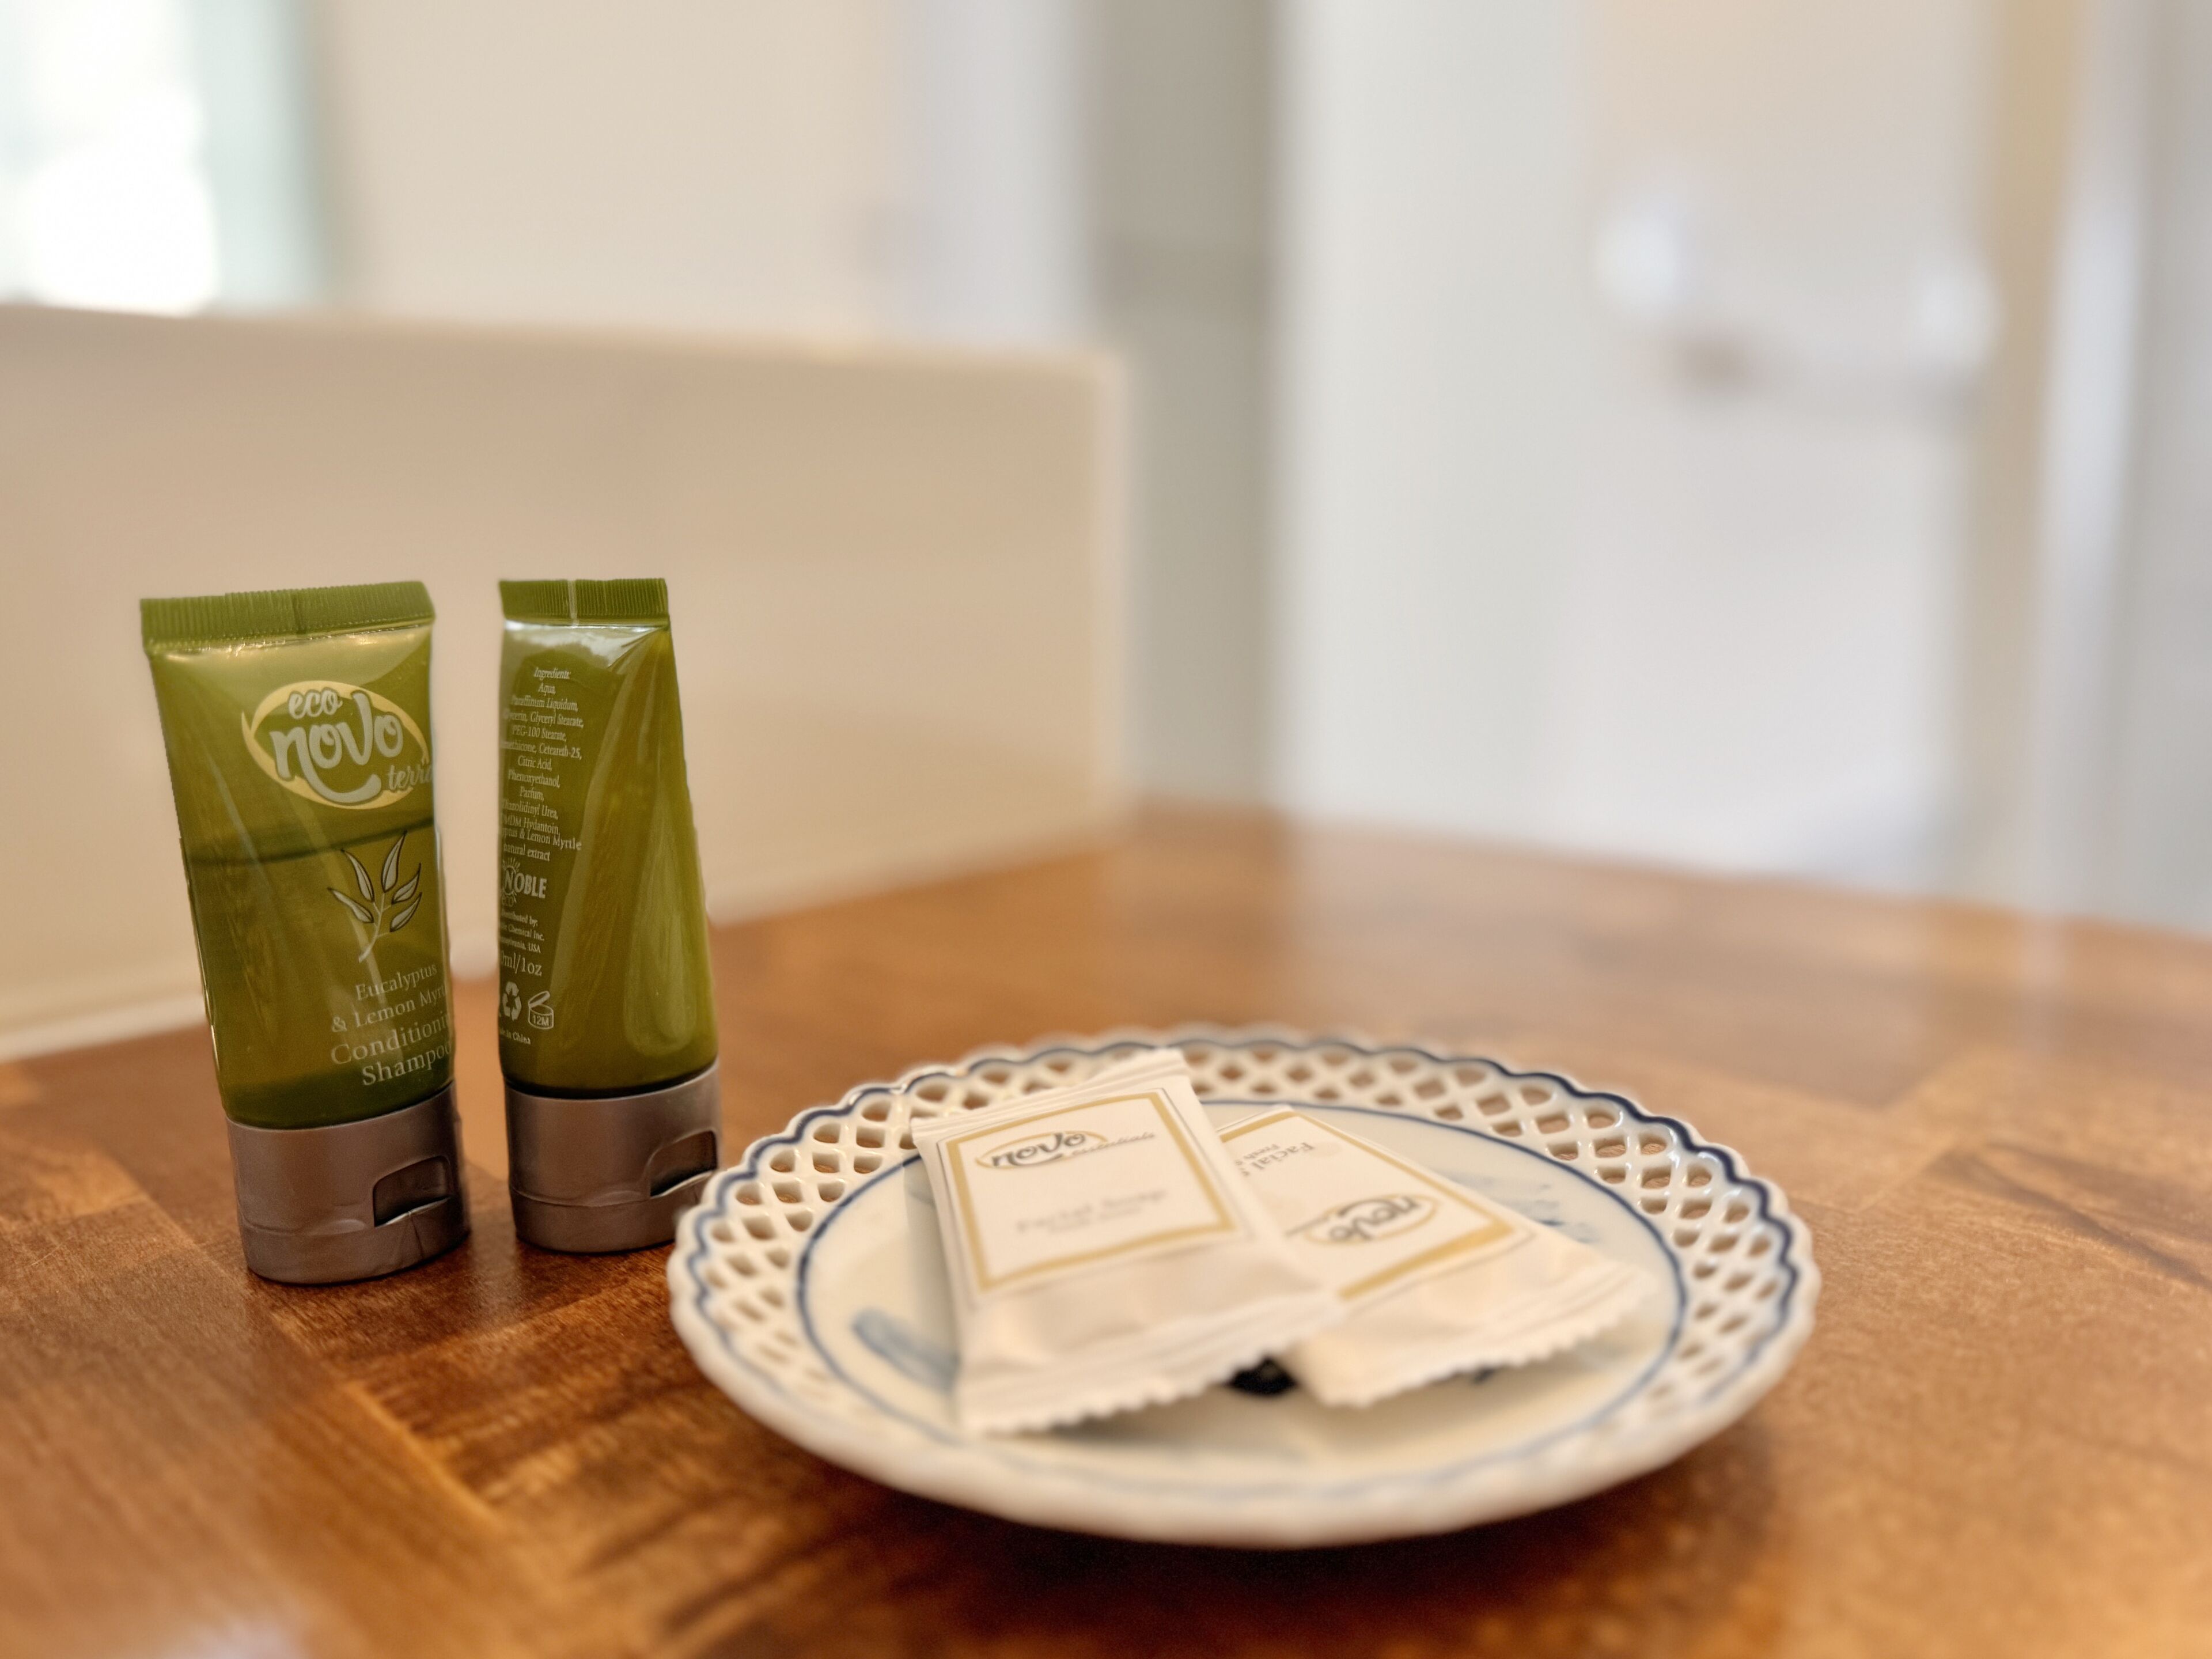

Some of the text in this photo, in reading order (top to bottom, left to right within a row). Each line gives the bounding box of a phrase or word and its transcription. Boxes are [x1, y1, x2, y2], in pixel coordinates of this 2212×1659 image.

[289, 690, 343, 719] eco
[518, 756, 536, 768] Citric
[527, 828, 550, 844] Lemon
[553, 835, 582, 850] Myrtle
[527, 848, 550, 862] extract
[505, 869, 547, 899] NOBLE
[528, 942, 541, 954] USA
[355, 964, 437, 1001] Eucalyptus
[331, 1016, 347, 1033] &
[354, 999, 416, 1028] Lemon
[533, 1014, 549, 1026] 12M
[331, 1010, 449, 1065] Conditioni
[513, 1032, 531, 1045] China
